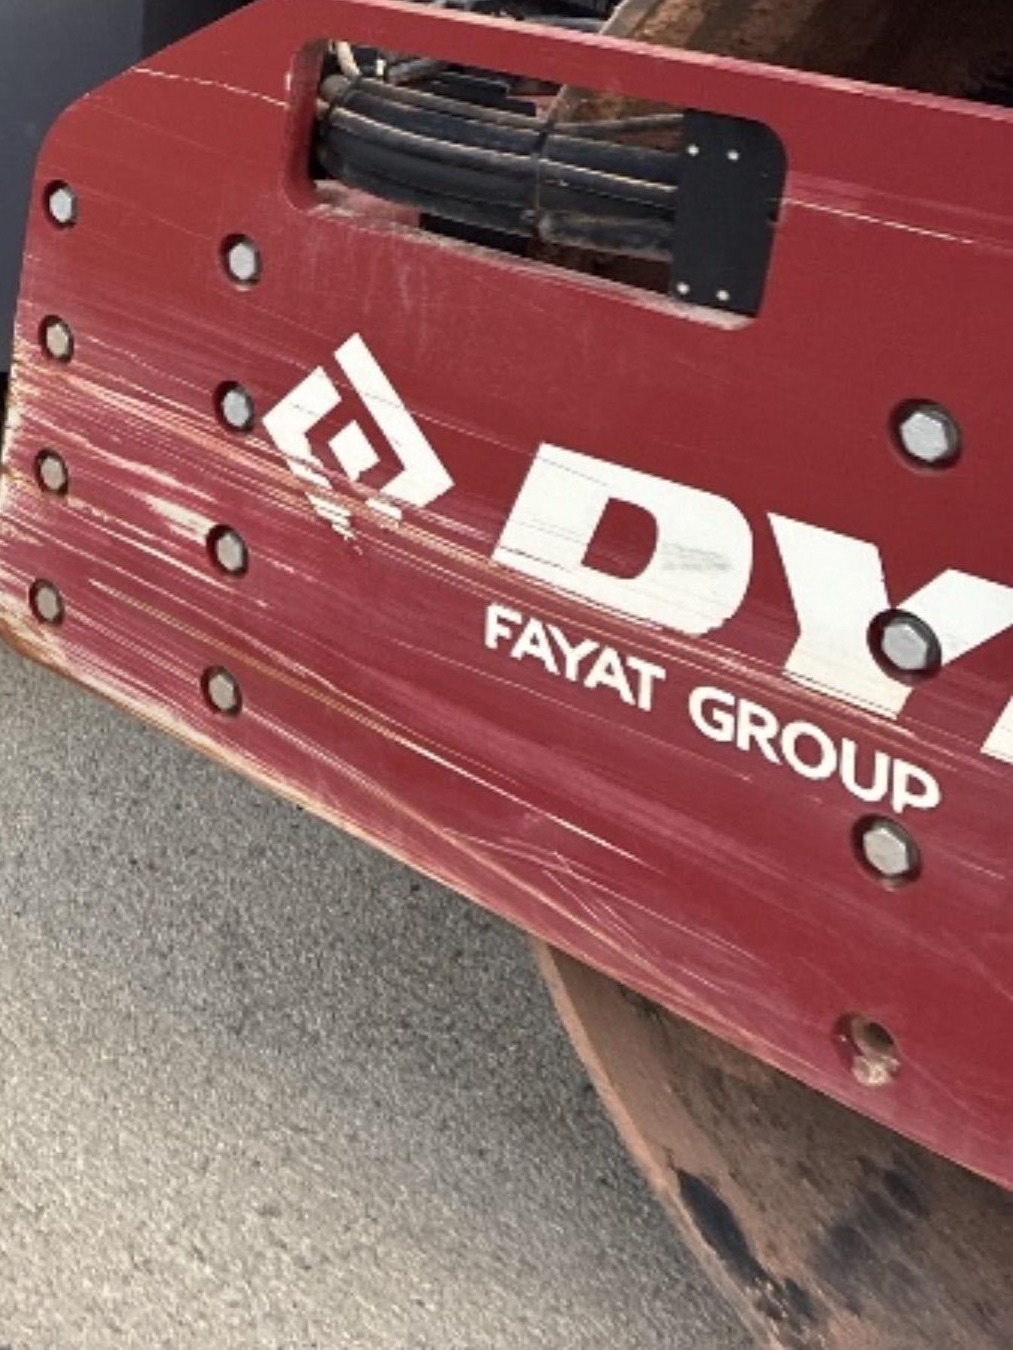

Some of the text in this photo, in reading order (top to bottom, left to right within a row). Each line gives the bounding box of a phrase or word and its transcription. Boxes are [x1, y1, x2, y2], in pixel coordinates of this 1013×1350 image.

[484, 602, 941, 814] FAYAT GROUP
[491, 442, 1013, 766] DY
